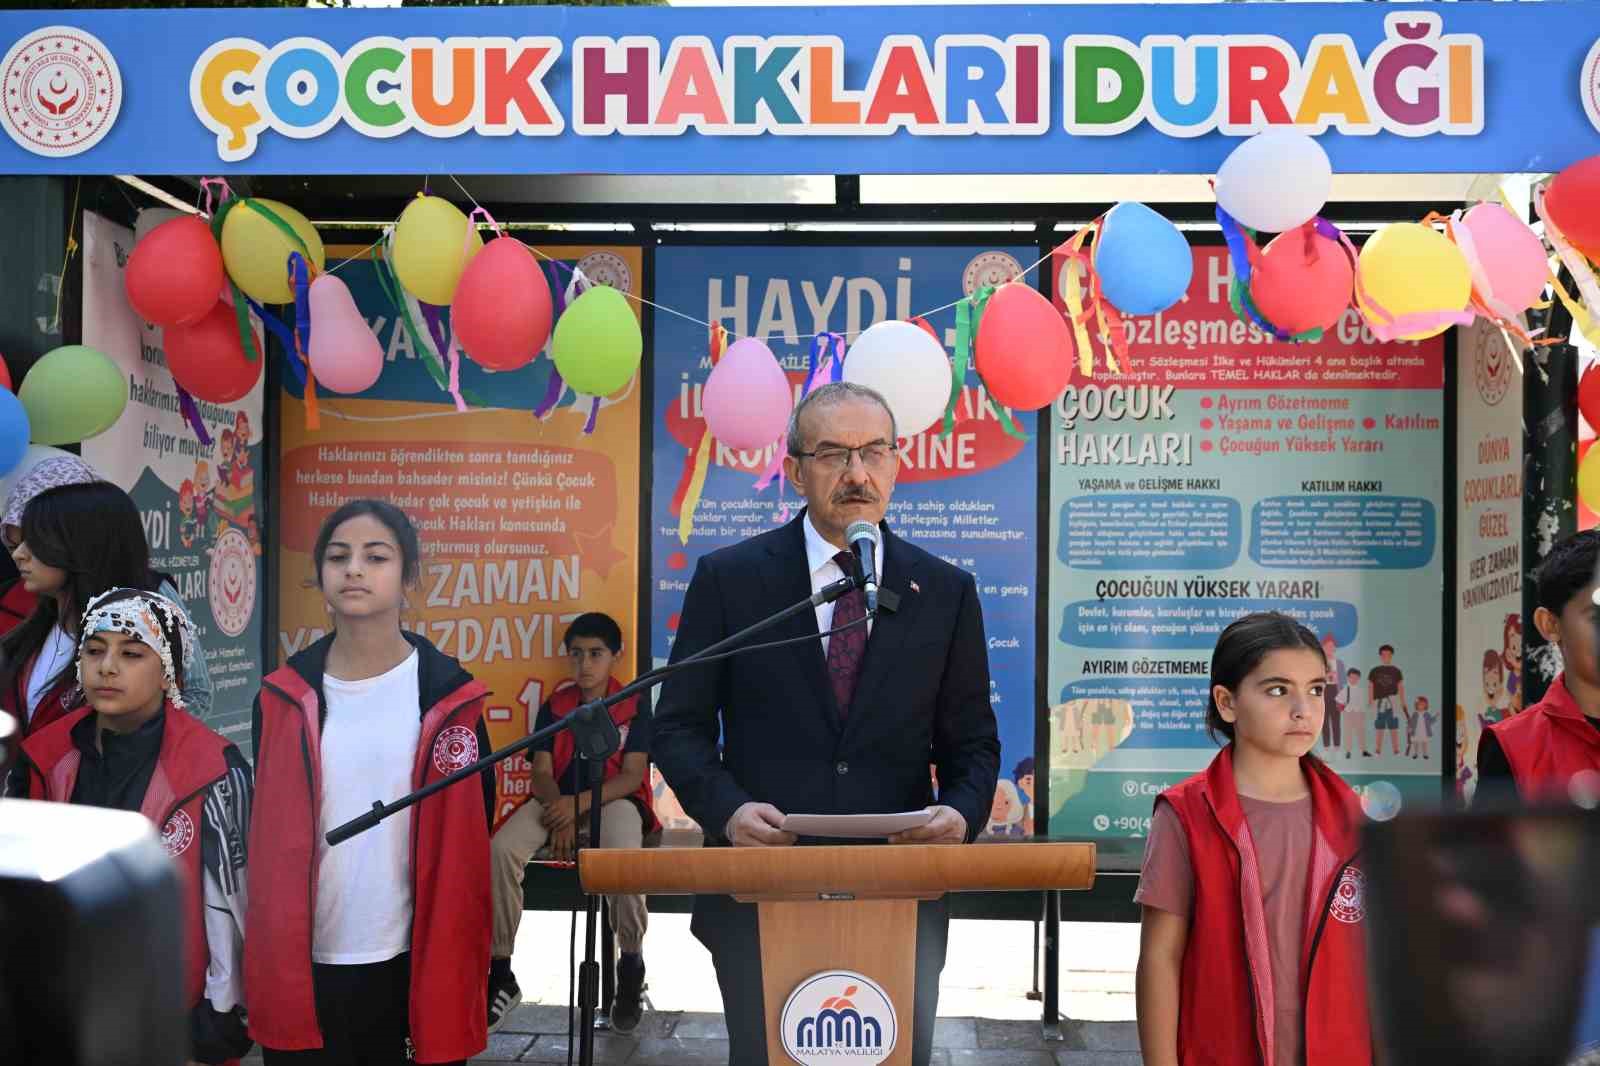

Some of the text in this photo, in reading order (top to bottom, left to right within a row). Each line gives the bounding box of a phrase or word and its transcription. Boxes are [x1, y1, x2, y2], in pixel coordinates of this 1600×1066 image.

[191, 38, 563, 160] ÇOCUK
[573, 36, 1049, 135] HAKLARI
[1063, 13, 1484, 137] DURAĞI
[707, 257, 913, 345] HAYDİ
[1150, 355, 1208, 368] Sözleşmesi
[1213, 354, 1235, 366] İlke
[1240, 358, 1251, 366] ve
[1256, 355, 1311, 366] Hükümleri
[1315, 355, 1322, 366] 4
[1327, 357, 1345, 366] ana
[1350, 355, 1382, 368] başlık
[1386, 355, 1425, 366] altında
[1166, 370, 1206, 380] Bunlara
[1210, 370, 1248, 380] TEMEL
[1254, 371, 1300, 380] HAKLAR
[1304, 370, 1318, 380] da
[1322, 370, 1400, 380] denilmektedir.
[1057, 384, 1176, 430] ÇOCUK
[1218, 394, 1349, 412] Ayrım Gözetmeme
[1218, 413, 1440, 435] Yaşama ve Gelişme Katılım
[143, 420, 176, 459] biliyor
[1219, 435, 1383, 456] Çocuğun Yüksek Yararı
[318, 445, 575, 468] Haklarınızı öğrendikten sonra tanıdığınız
[1057, 432, 1192, 466] HAKLARI
[1478, 434, 1510, 464] DÜNYA
[296, 469, 595, 491] herkese bundan bahseder misiniz! Çünkü Çocuk
[1079, 476, 1220, 493] YAŞAMA ve GELİŞME HAKKI
[1301, 480, 1382, 492] KATILIM HAKKI
[429, 493, 450, 511] çok
[454, 494, 489, 513] çocuk
[495, 499, 507, 509] ve
[512, 496, 561, 513] yetişkin
[566, 495, 582, 509] ile
[917, 500, 944, 512] sahip
[949, 500, 995, 511] oldukları
[450, 516, 496, 531] Hakları
[500, 516, 566, 533] konusunda
[901, 515, 948, 526] Birleşmiş
[953, 515, 999, 526] Milletler
[1479, 507, 1509, 537] GÜZEL
[721, 526, 736, 536] bir
[912, 528, 956, 538] imzasına
[961, 529, 1027, 540] sunulmuştur.
[484, 537, 549, 555] olursunuz.
[962, 558, 975, 566] ve
[426, 554, 581, 608] ZAMAN
[984, 584, 1028, 595] en geniş
[1096, 575, 1319, 602] ÇOCUĞUN YÜKSEK YARARI
[1078, 606, 1109, 618] Devlet,
[1112, 606, 1154, 618] kurumlar,
[1158, 606, 1202, 620] kuruluşlar
[1206, 609, 1216, 617] ve
[1310, 608, 1334, 620] çocuk
[1078, 623, 1095, 635] için
[1098, 624, 1108, 633] en
[1110, 623, 1122, 636] iyi
[1151, 624, 1187, 636] çocuğun
[1190, 623, 1219, 636] yüksek
[988, 637, 1020, 649] Çocuk
[1082, 657, 1208, 674] AYIRIM GÖZETMEME
[796, 1048, 841, 1056] MALATYA
